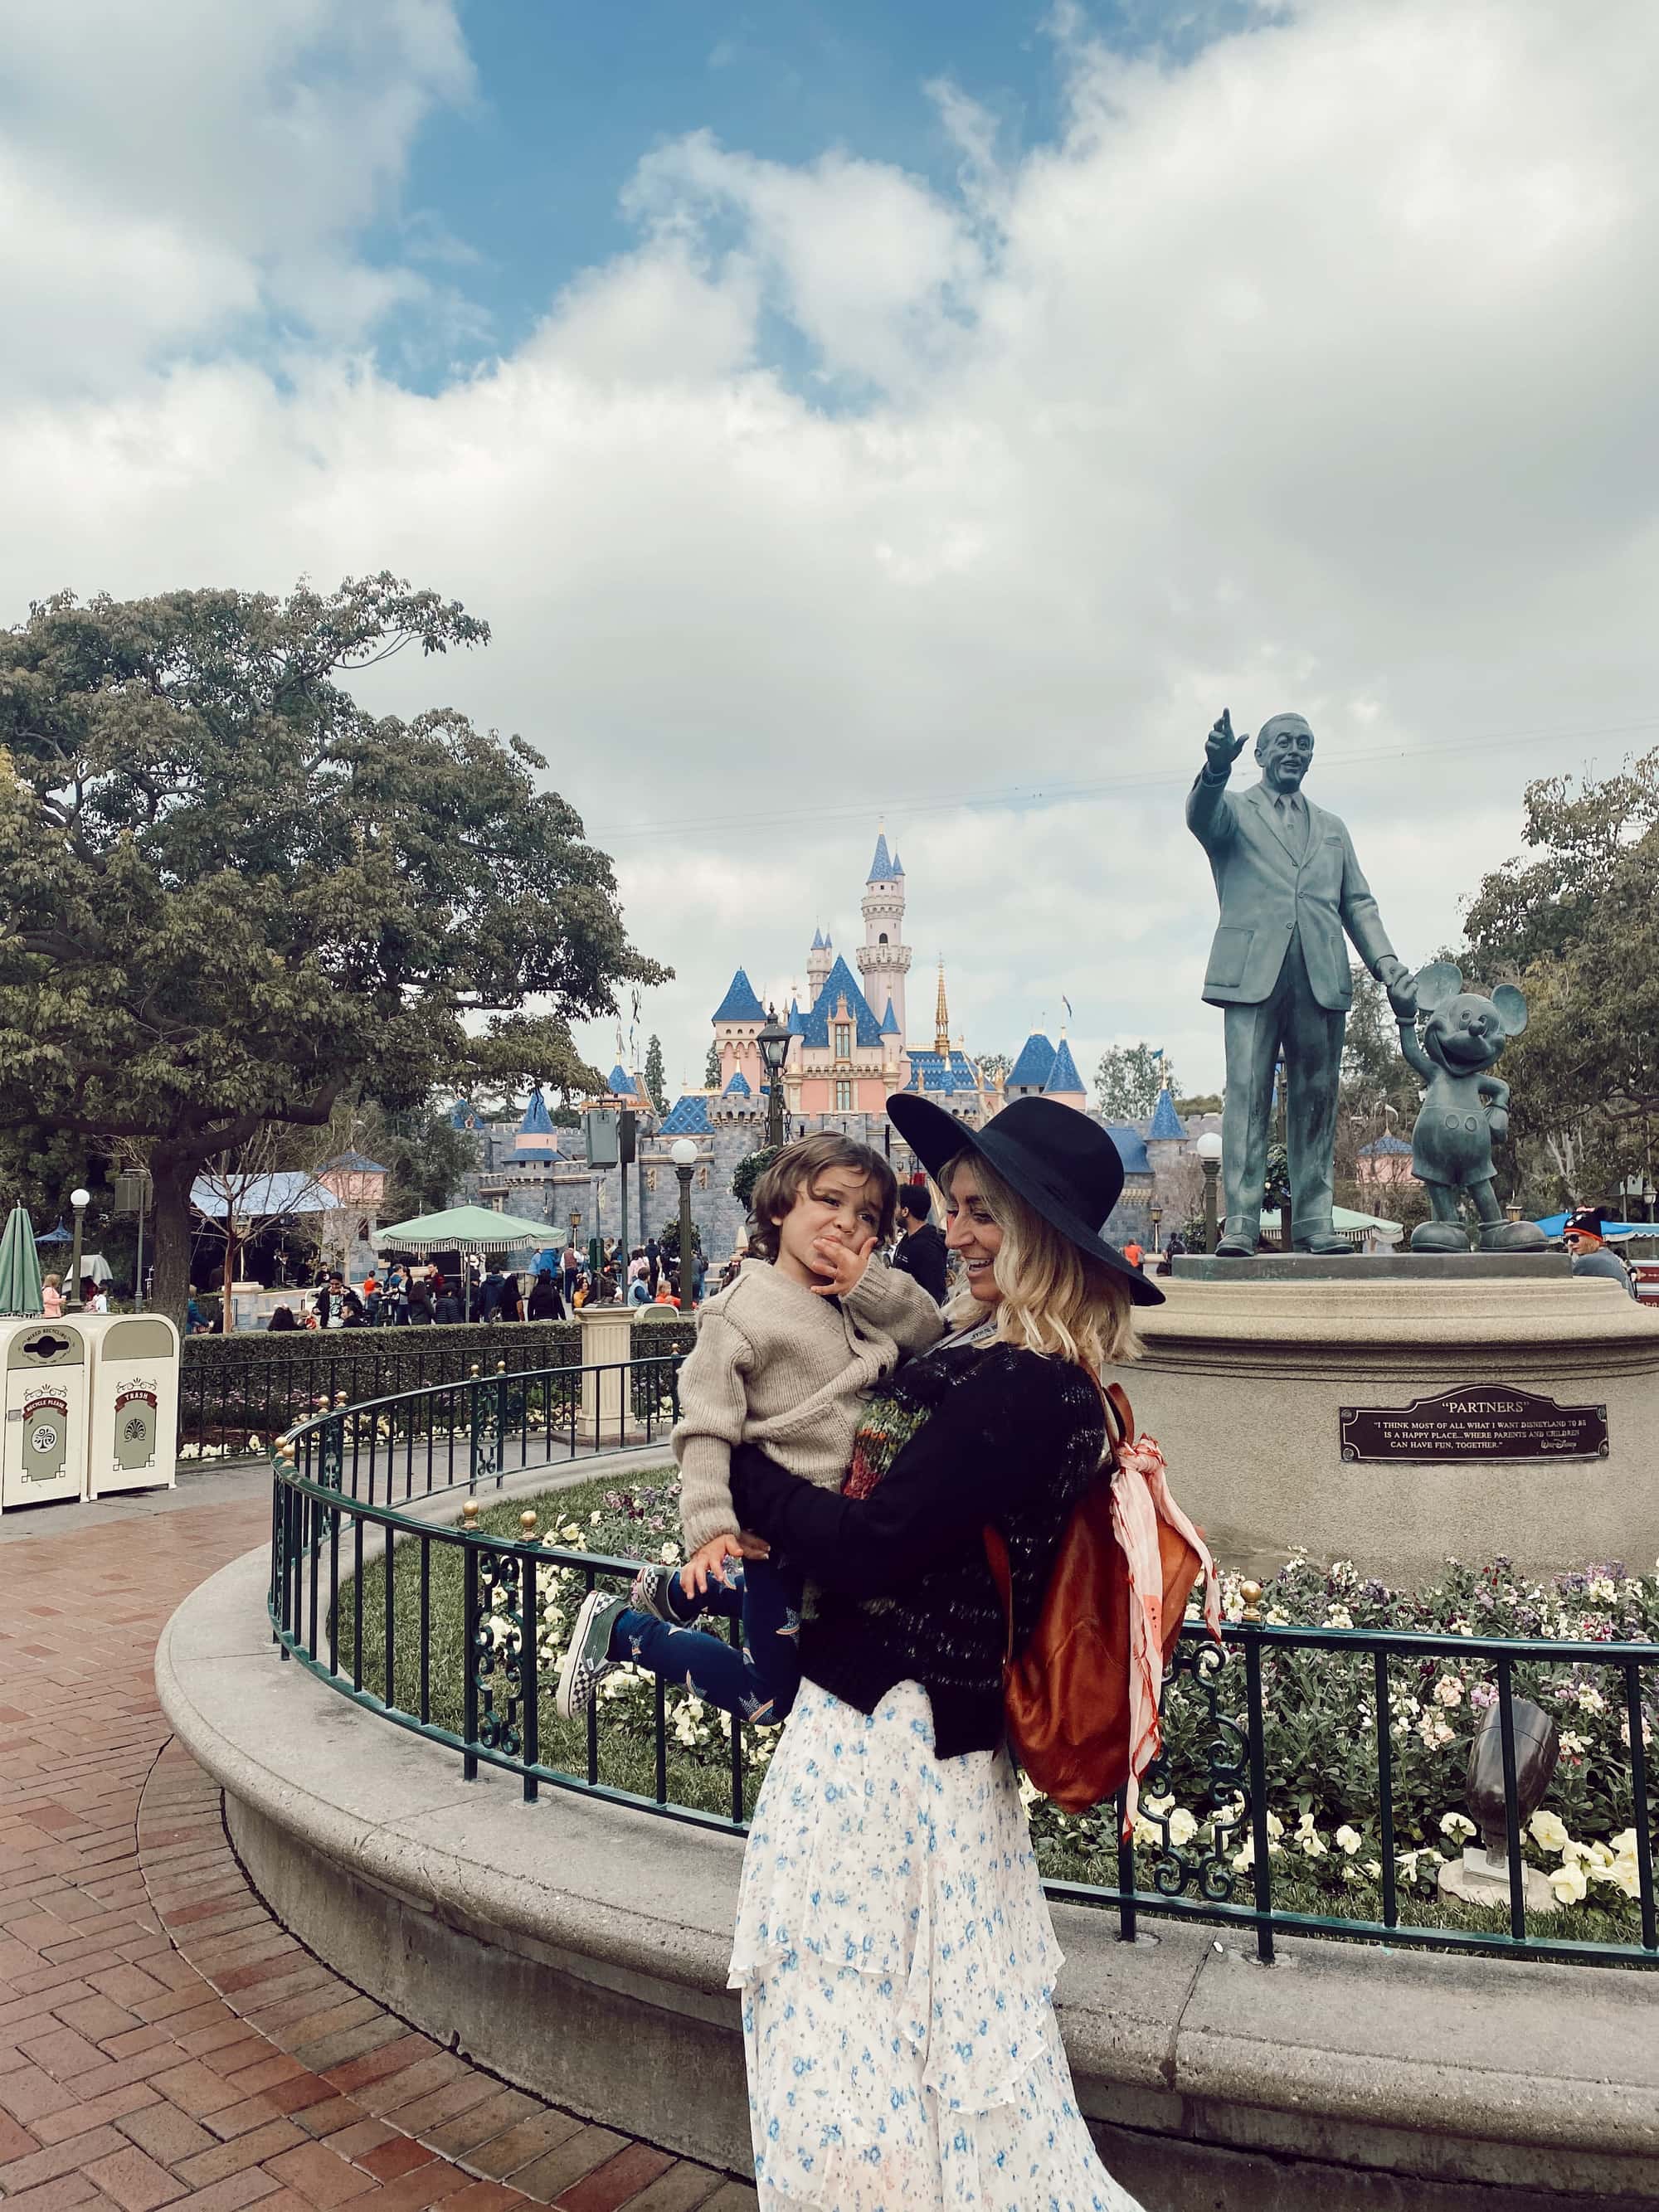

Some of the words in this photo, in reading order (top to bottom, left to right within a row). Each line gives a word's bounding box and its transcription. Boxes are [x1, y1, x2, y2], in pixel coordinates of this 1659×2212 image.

[124, 1393, 148, 1401] TRASH
[27, 1400, 46, 1412] RECYCLE
[47, 1400, 66, 1408] PLEASE
